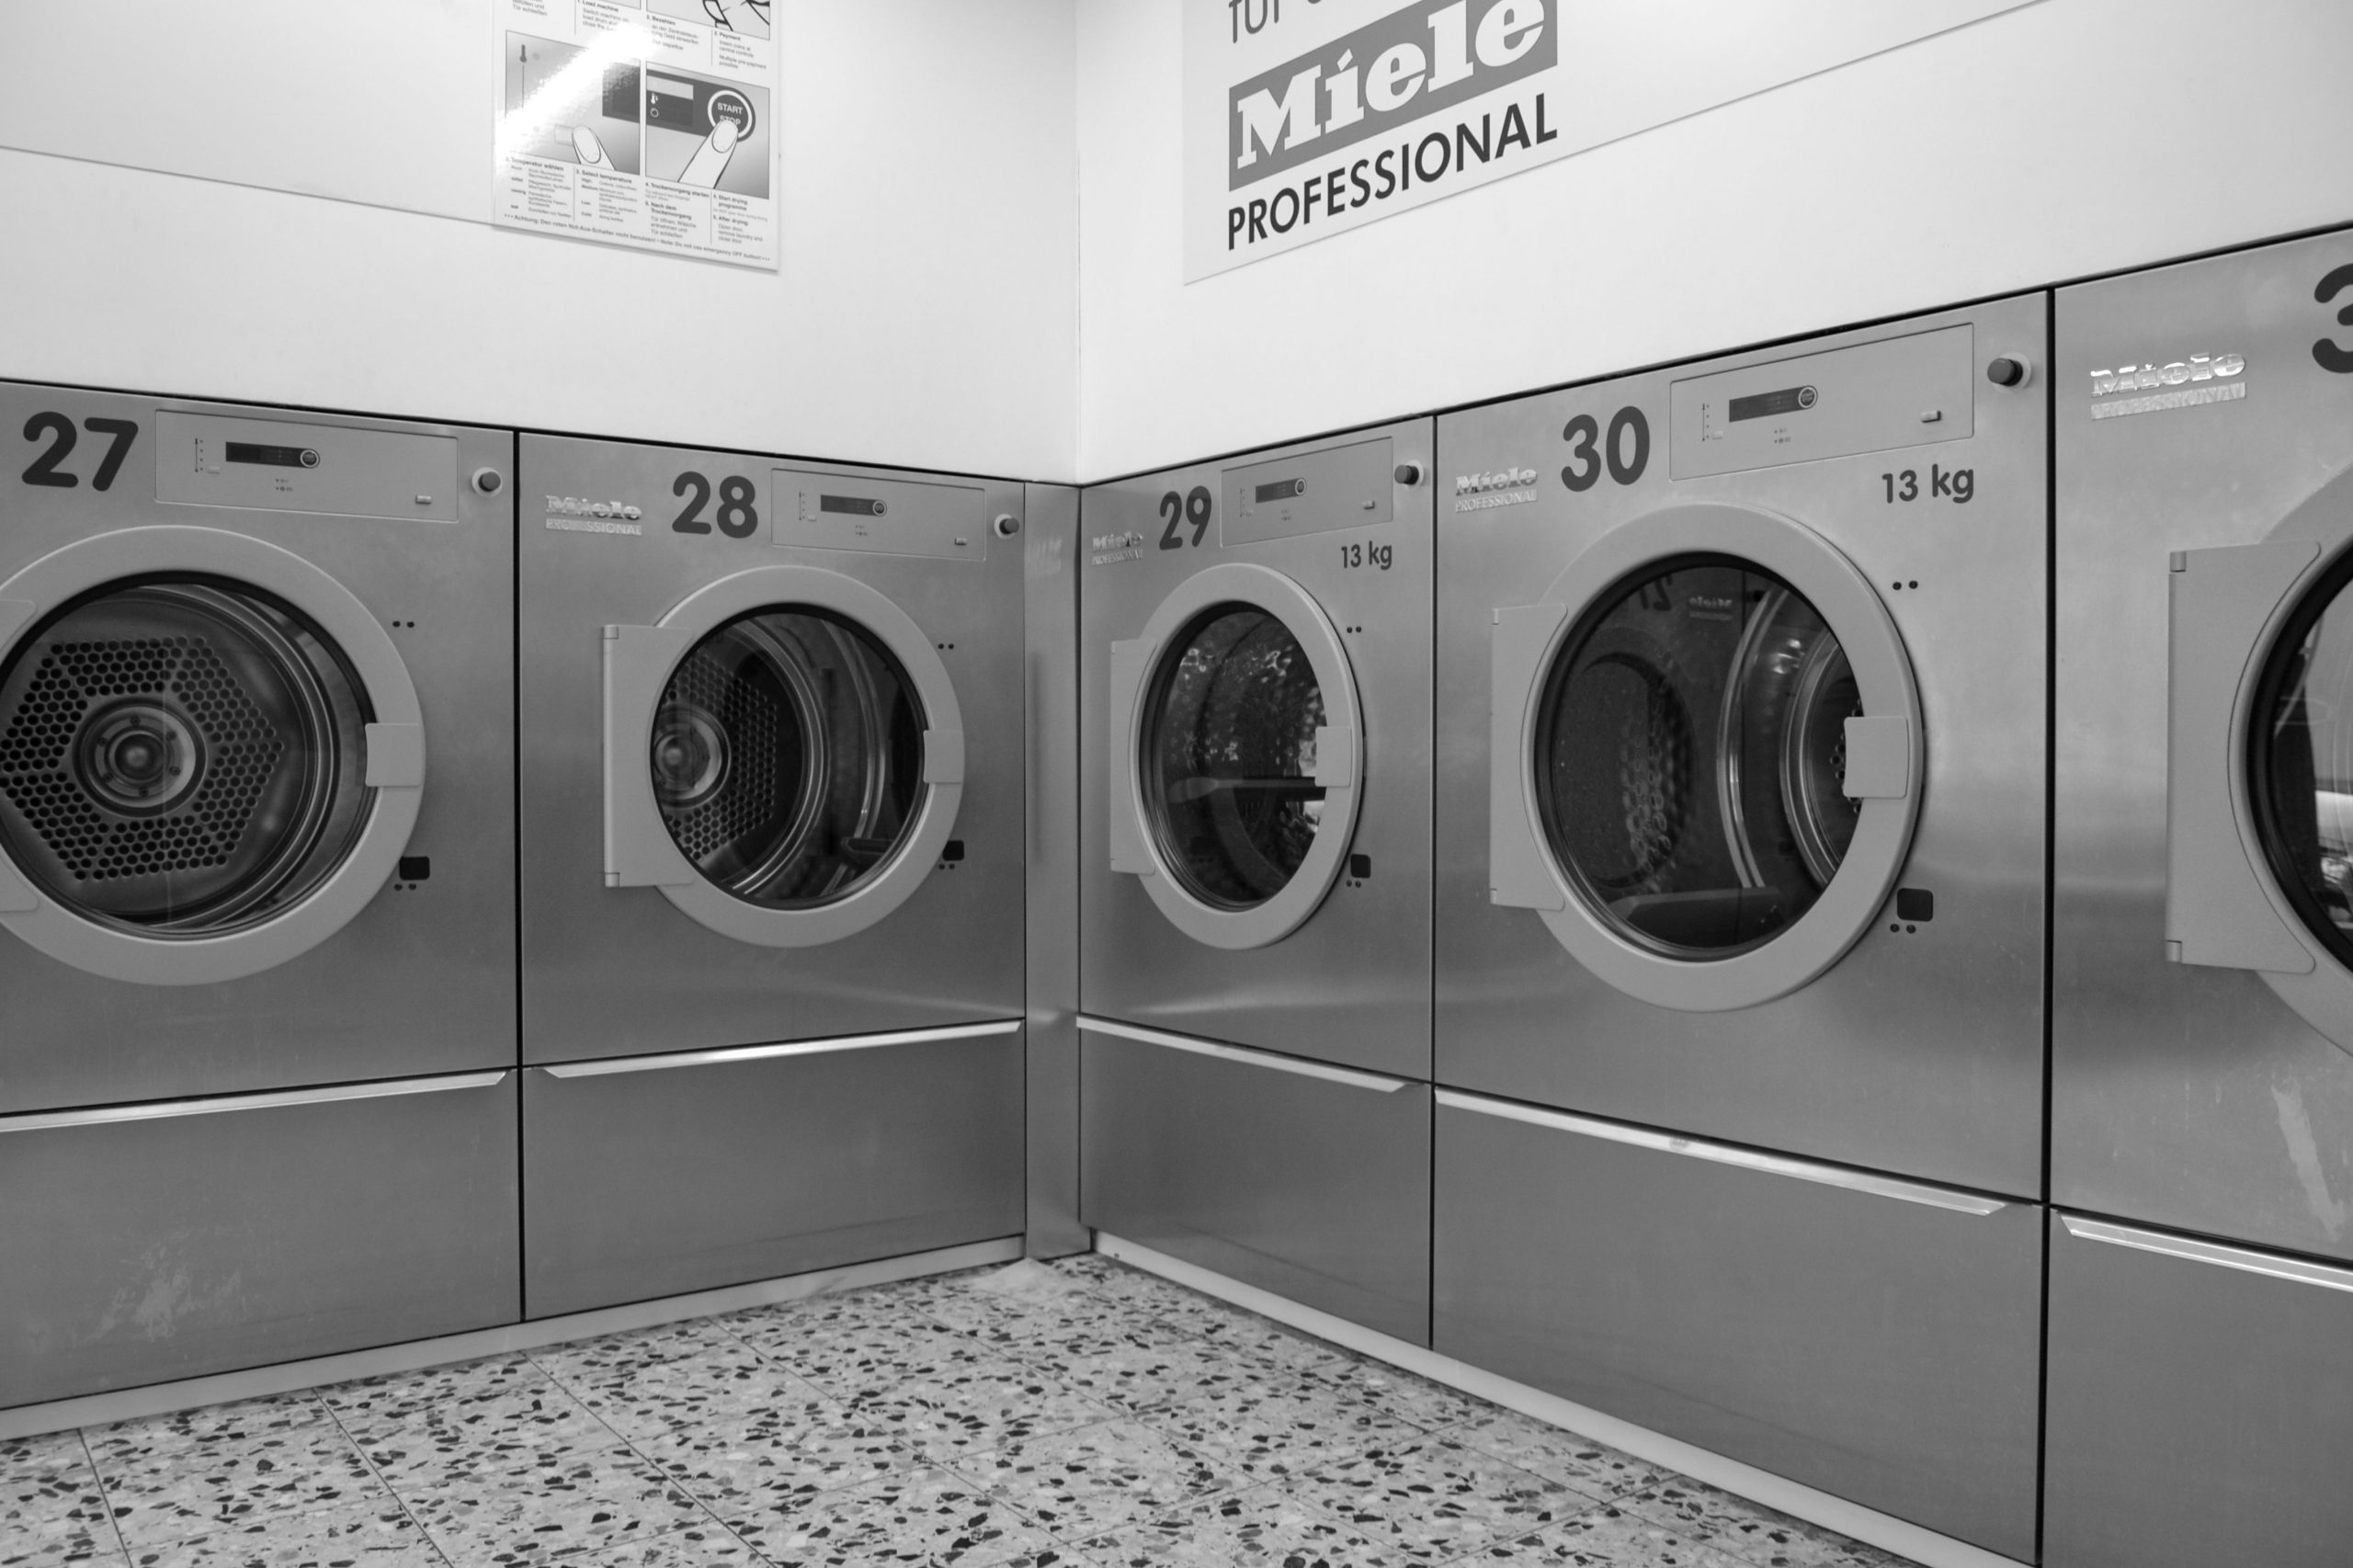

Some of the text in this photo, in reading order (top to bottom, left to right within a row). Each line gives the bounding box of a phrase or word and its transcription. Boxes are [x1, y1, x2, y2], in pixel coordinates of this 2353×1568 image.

[1238, 0, 1545, 170] Miele
[717, 102, 743, 115] START
[1229, 93, 1558, 251] PROFESSIONAL
[2090, 353, 2245, 397] Miele
[21, 411, 139, 492] 27
[1561, 405, 1651, 493] 30
[1455, 489, 1538, 514] PROFESSIONAL
[1456, 467, 1538, 496] Miele
[1881, 463, 1975, 504] 13 kg
[545, 494, 642, 521] Miele
[672, 471, 758, 540] 28
[1158, 485, 1212, 551] 29
[1340, 540, 1393, 571] 13 kg
